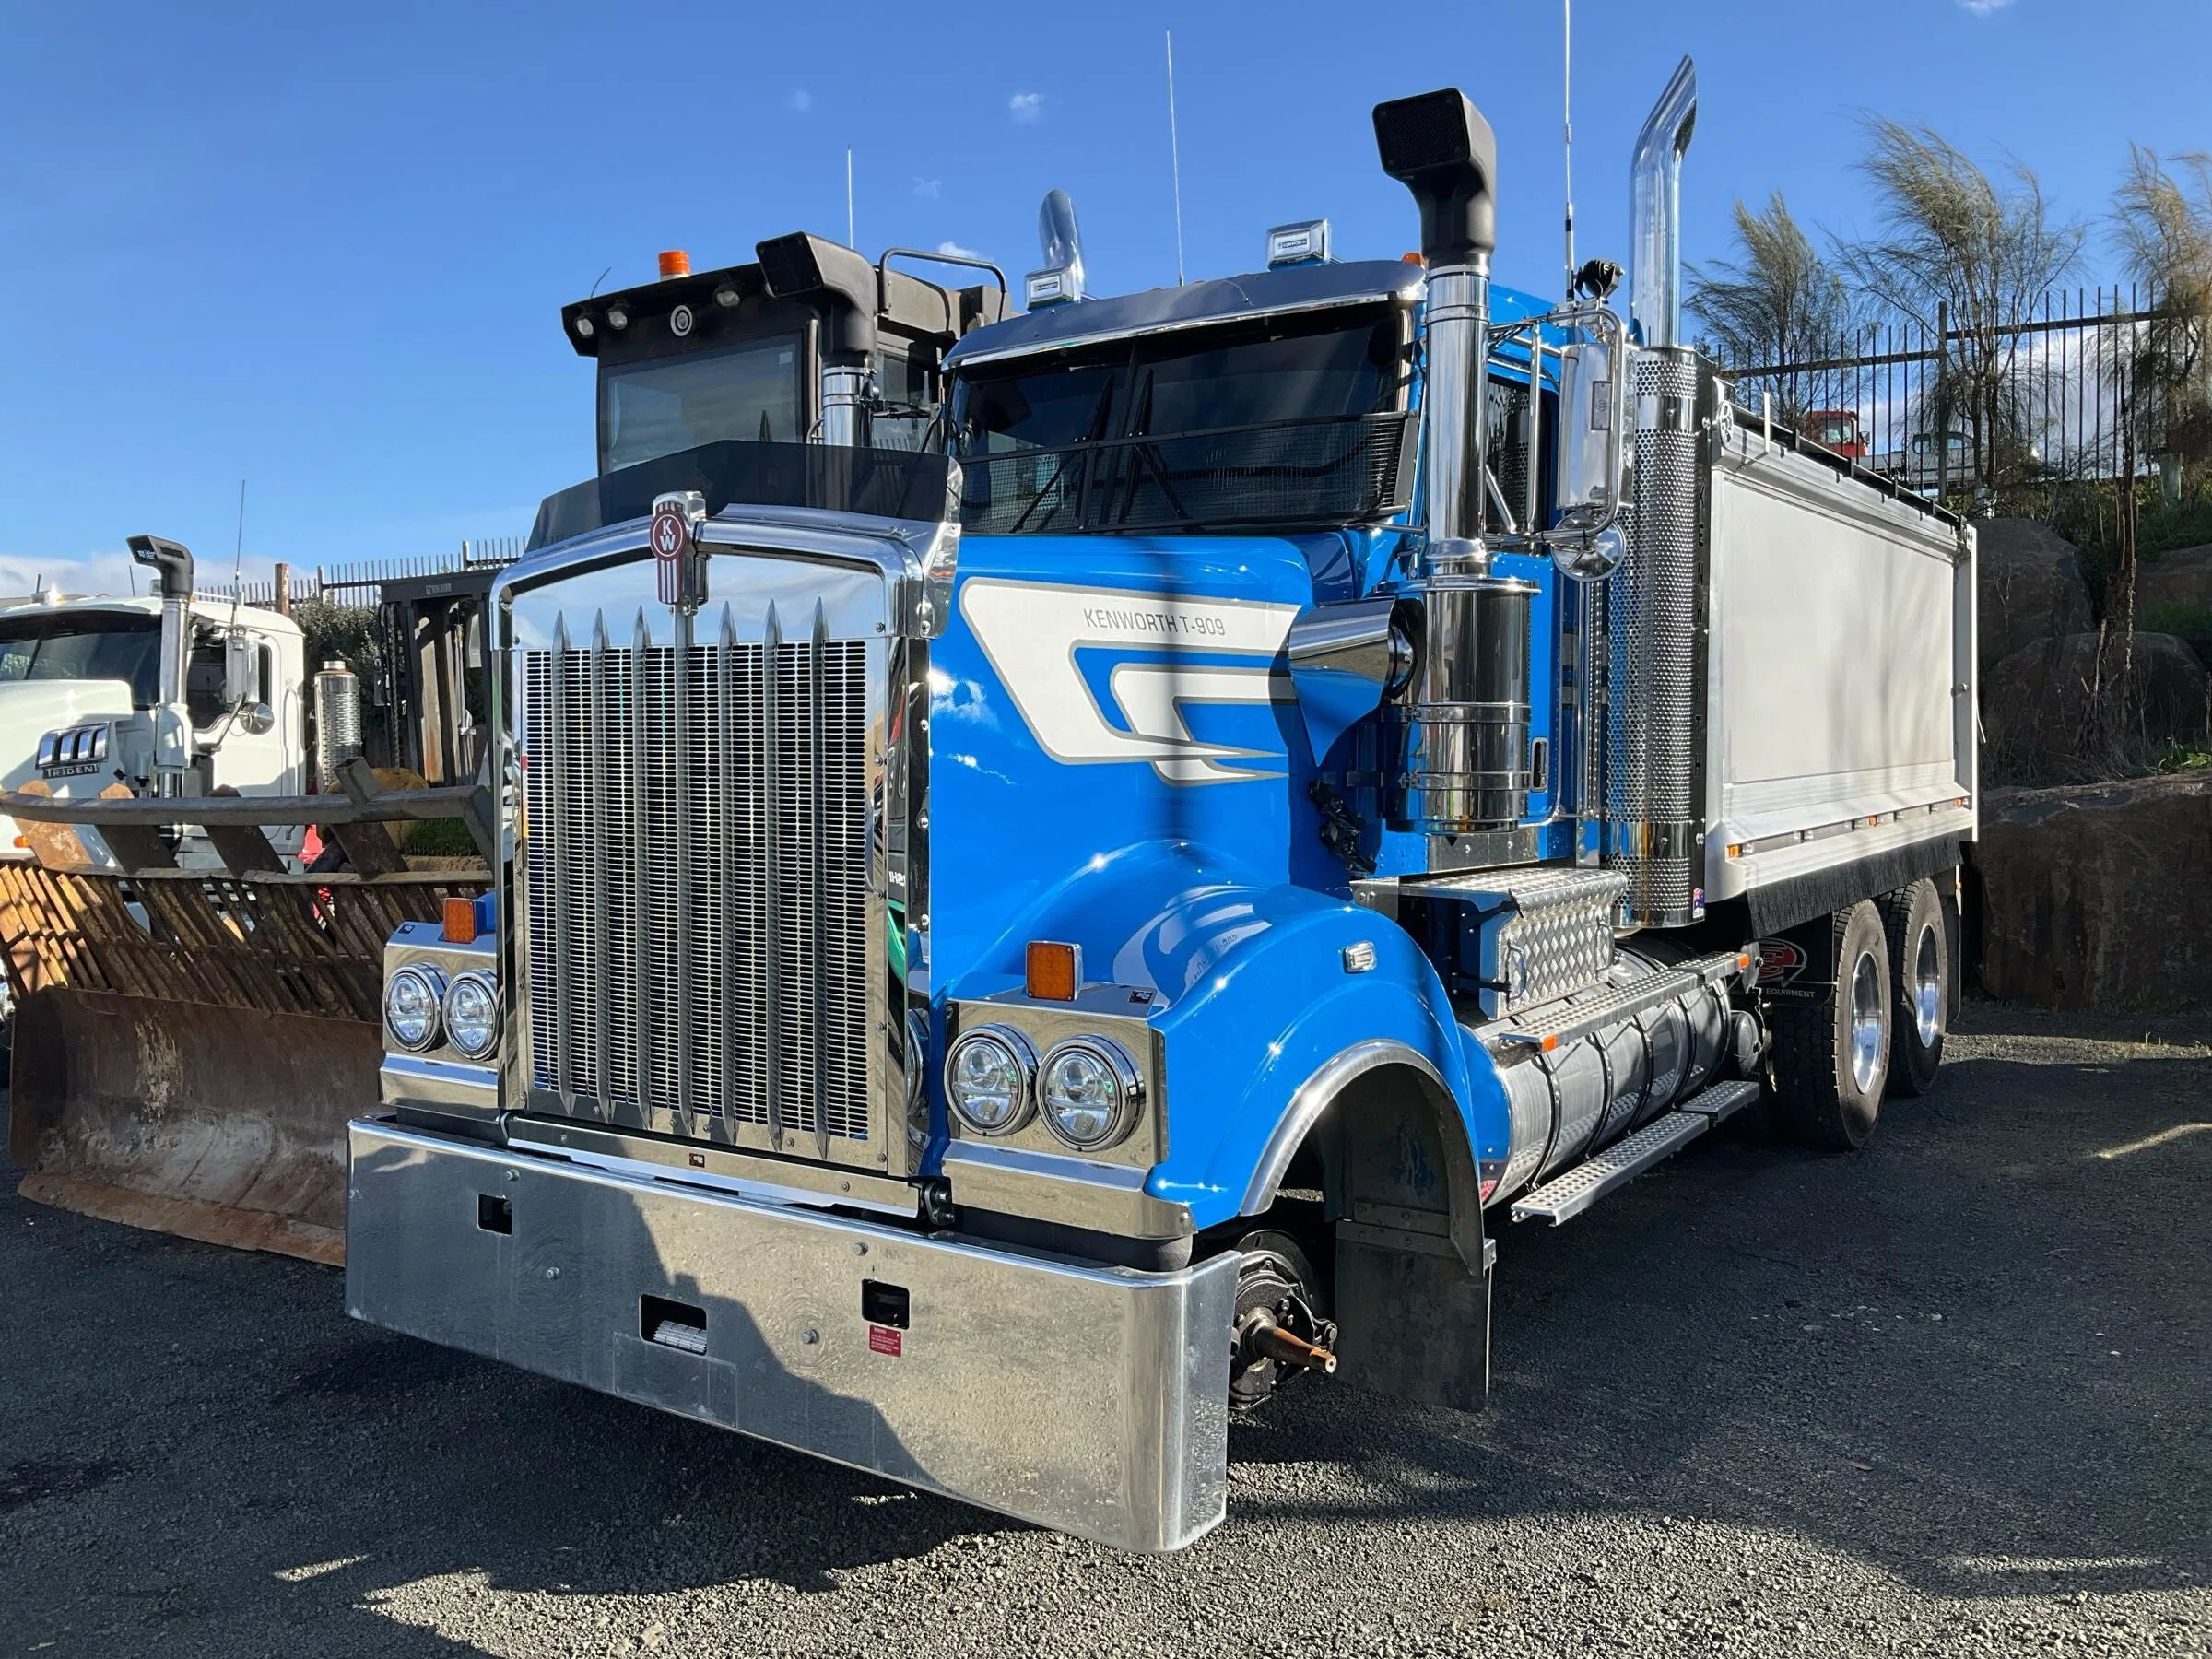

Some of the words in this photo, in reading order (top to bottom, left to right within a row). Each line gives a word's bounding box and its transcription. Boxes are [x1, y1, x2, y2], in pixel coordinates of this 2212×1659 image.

[1083, 608, 1178, 633] KENWORTH
[1180, 615, 1225, 636] T-909
[1694, 485, 1704, 778] KENWORTH
[46, 763, 98, 777] TRIDENT
[1765, 987, 1816, 998] EQUIPMENT
